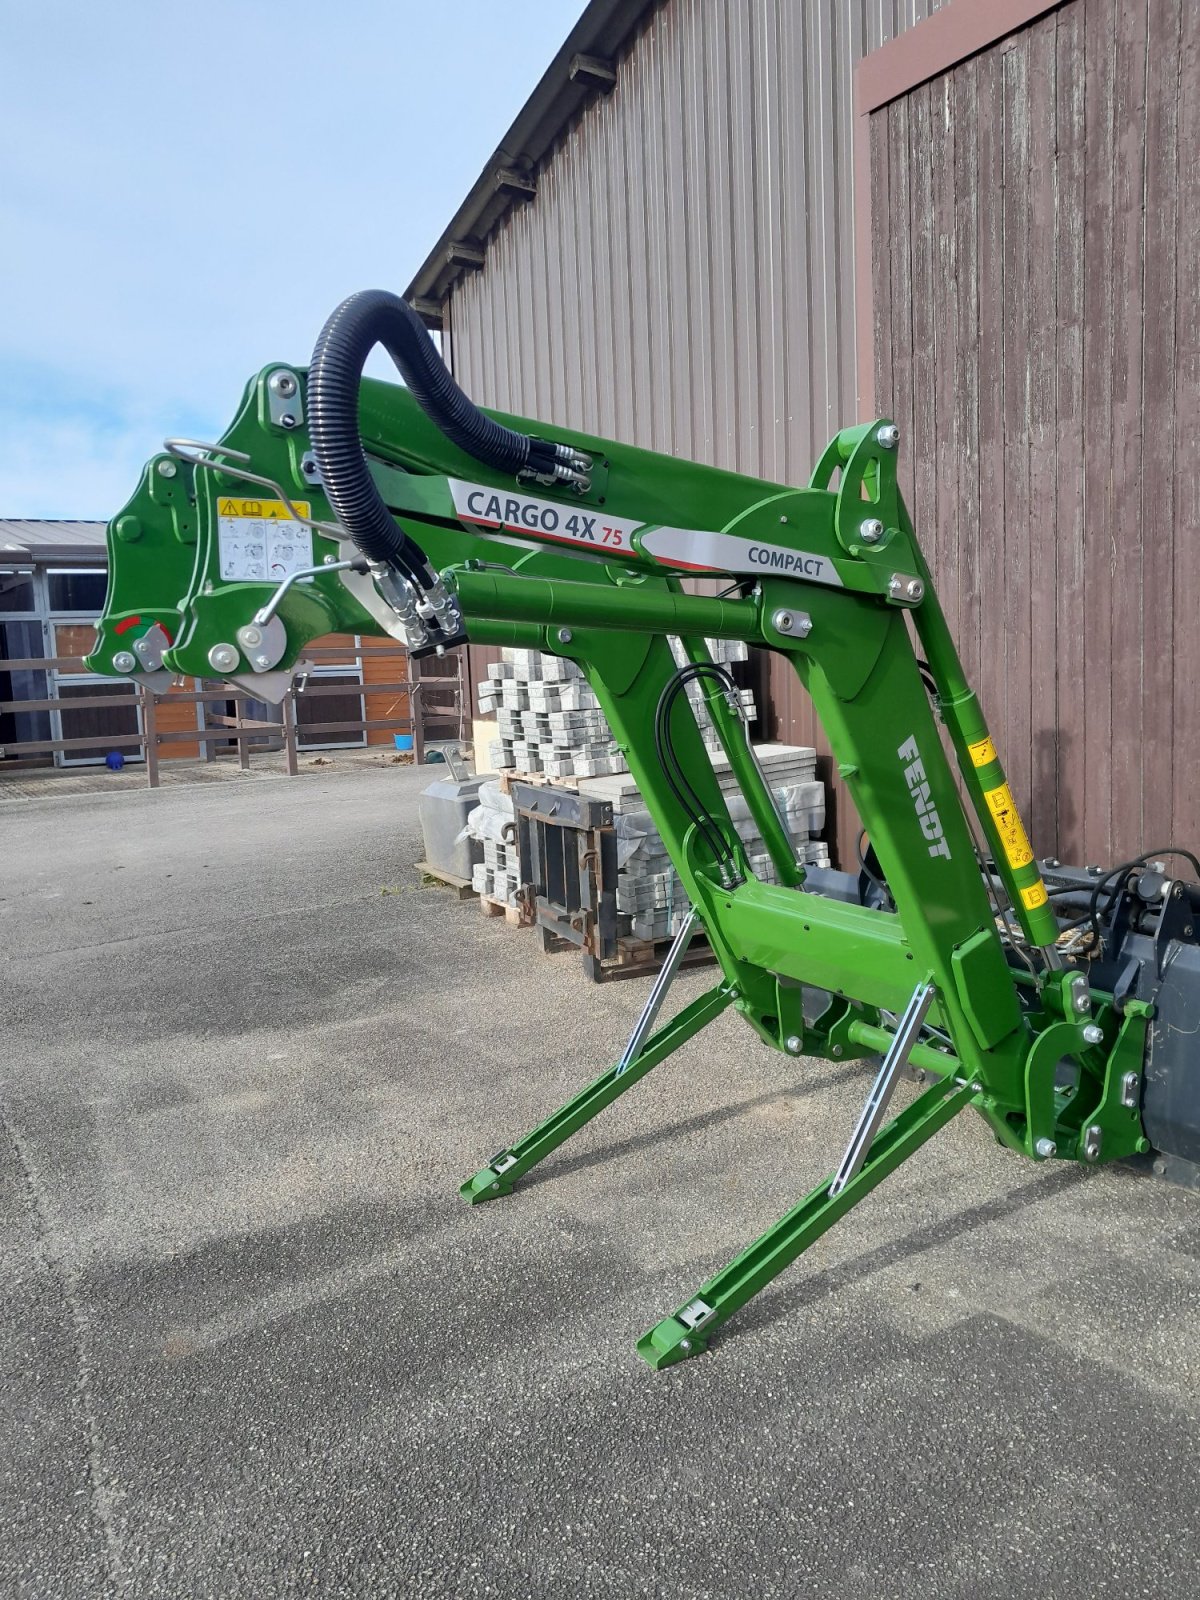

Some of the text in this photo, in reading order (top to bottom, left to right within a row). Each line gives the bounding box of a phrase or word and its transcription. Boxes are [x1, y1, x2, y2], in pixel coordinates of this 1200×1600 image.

[467, 491, 623, 546] CARGO 4X 75
[747, 547, 824, 577] COMPACT
[898, 735, 952, 860] FENDT
